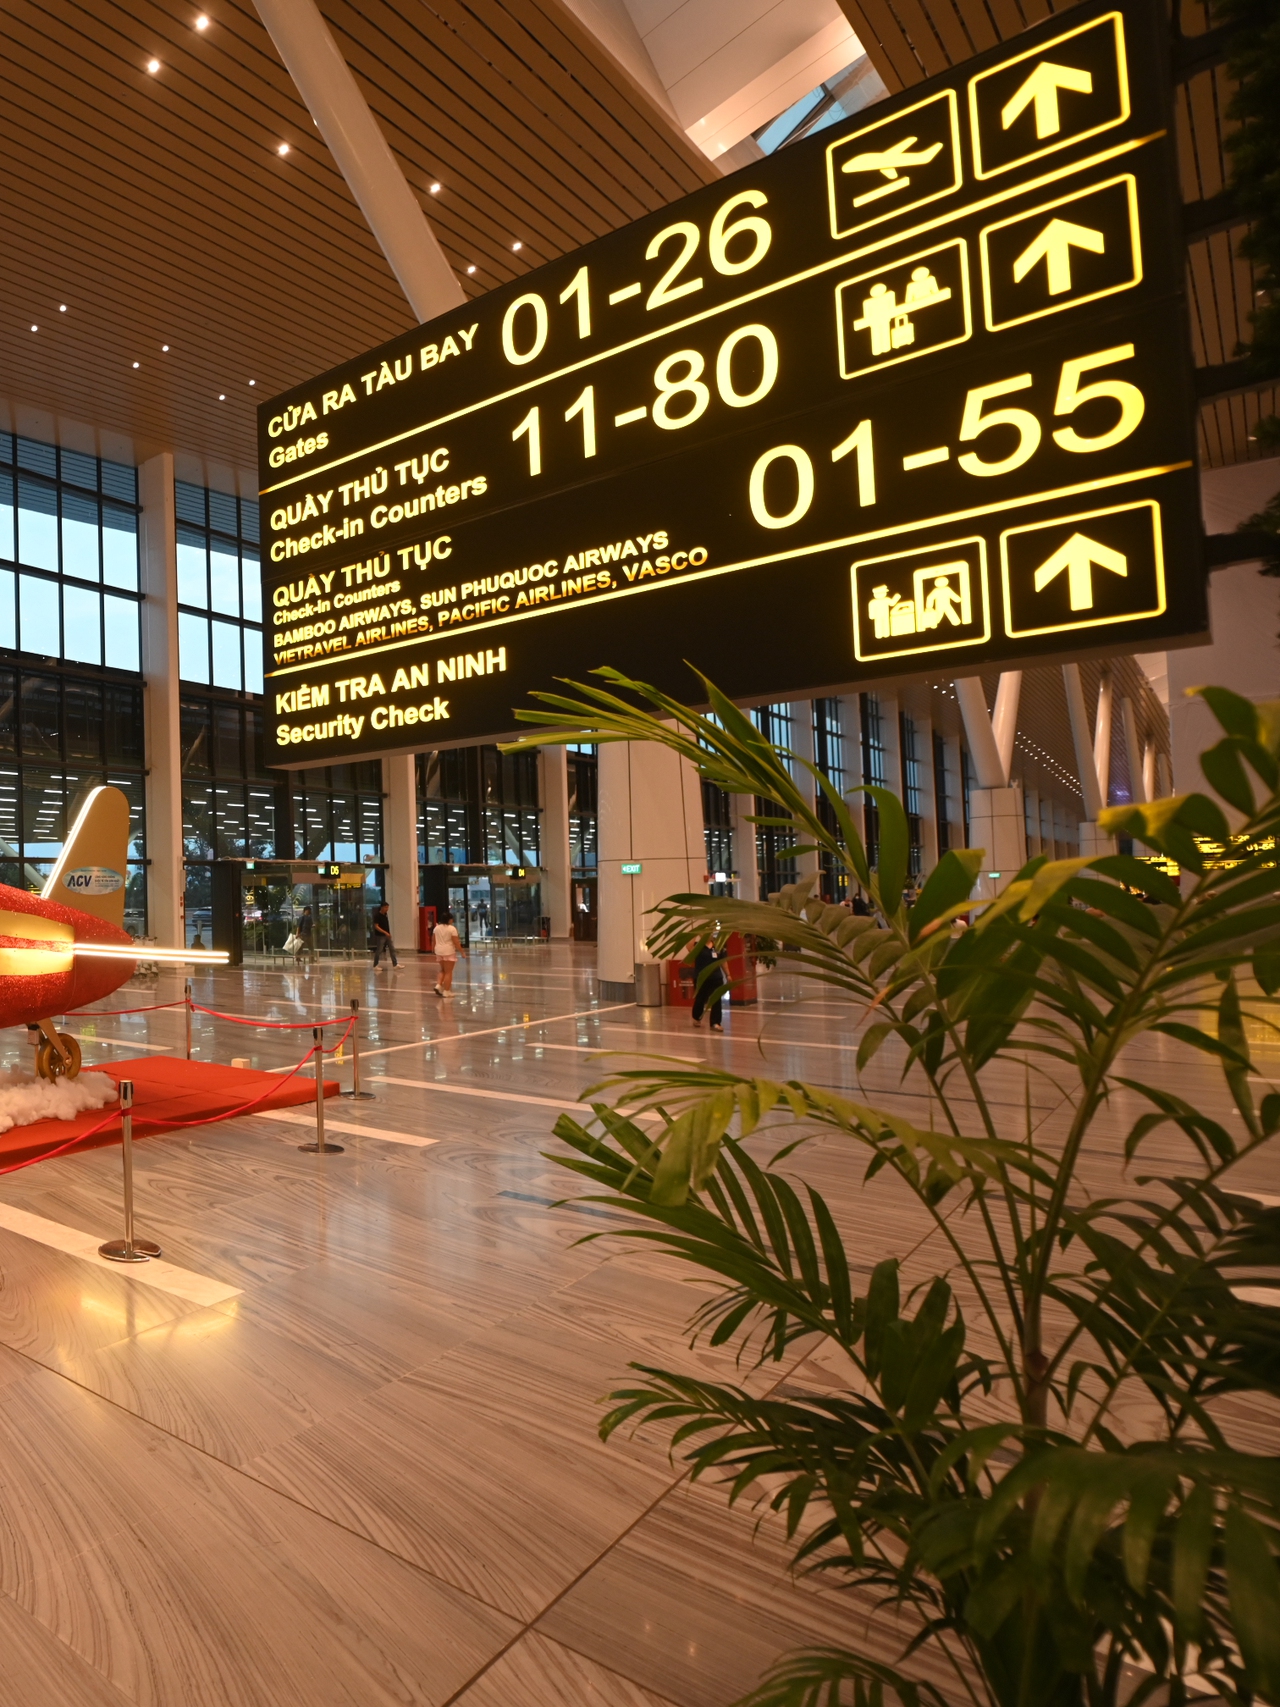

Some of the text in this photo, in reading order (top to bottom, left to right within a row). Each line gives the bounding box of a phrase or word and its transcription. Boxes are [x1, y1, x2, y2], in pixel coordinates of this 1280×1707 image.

[500, 188, 774, 368] 01-26
[268, 322, 479, 438] CỬA RA TÀU BAY
[511, 323, 780, 478] 11-80
[268, 431, 330, 469] Gates
[747, 342, 1147, 531] 01-55
[338, 466, 388, 507] THỦ
[394, 447, 450, 486] TỤC
[270, 475, 488, 563] Check-in Counters
[273, 530, 669, 648] BAMBOO AIRWAYS, SUN PHUQUOC AIRWAYS
[341, 550, 391, 588] THỦ
[396, 535, 453, 571] TỤC
[273, 546, 709, 666] VIETRAVEL AIRLINES, PACIFIC AIRLINES, VASCO
[333, 580, 401, 609] Counters
[335, 673, 386, 703] TRA
[391, 663, 430, 692] AN
[437, 646, 508, 684] NINH
[276, 696, 451, 746] Security Check
[67, 875, 92, 888] ACV
[626, 864, 640, 873] EXIT
